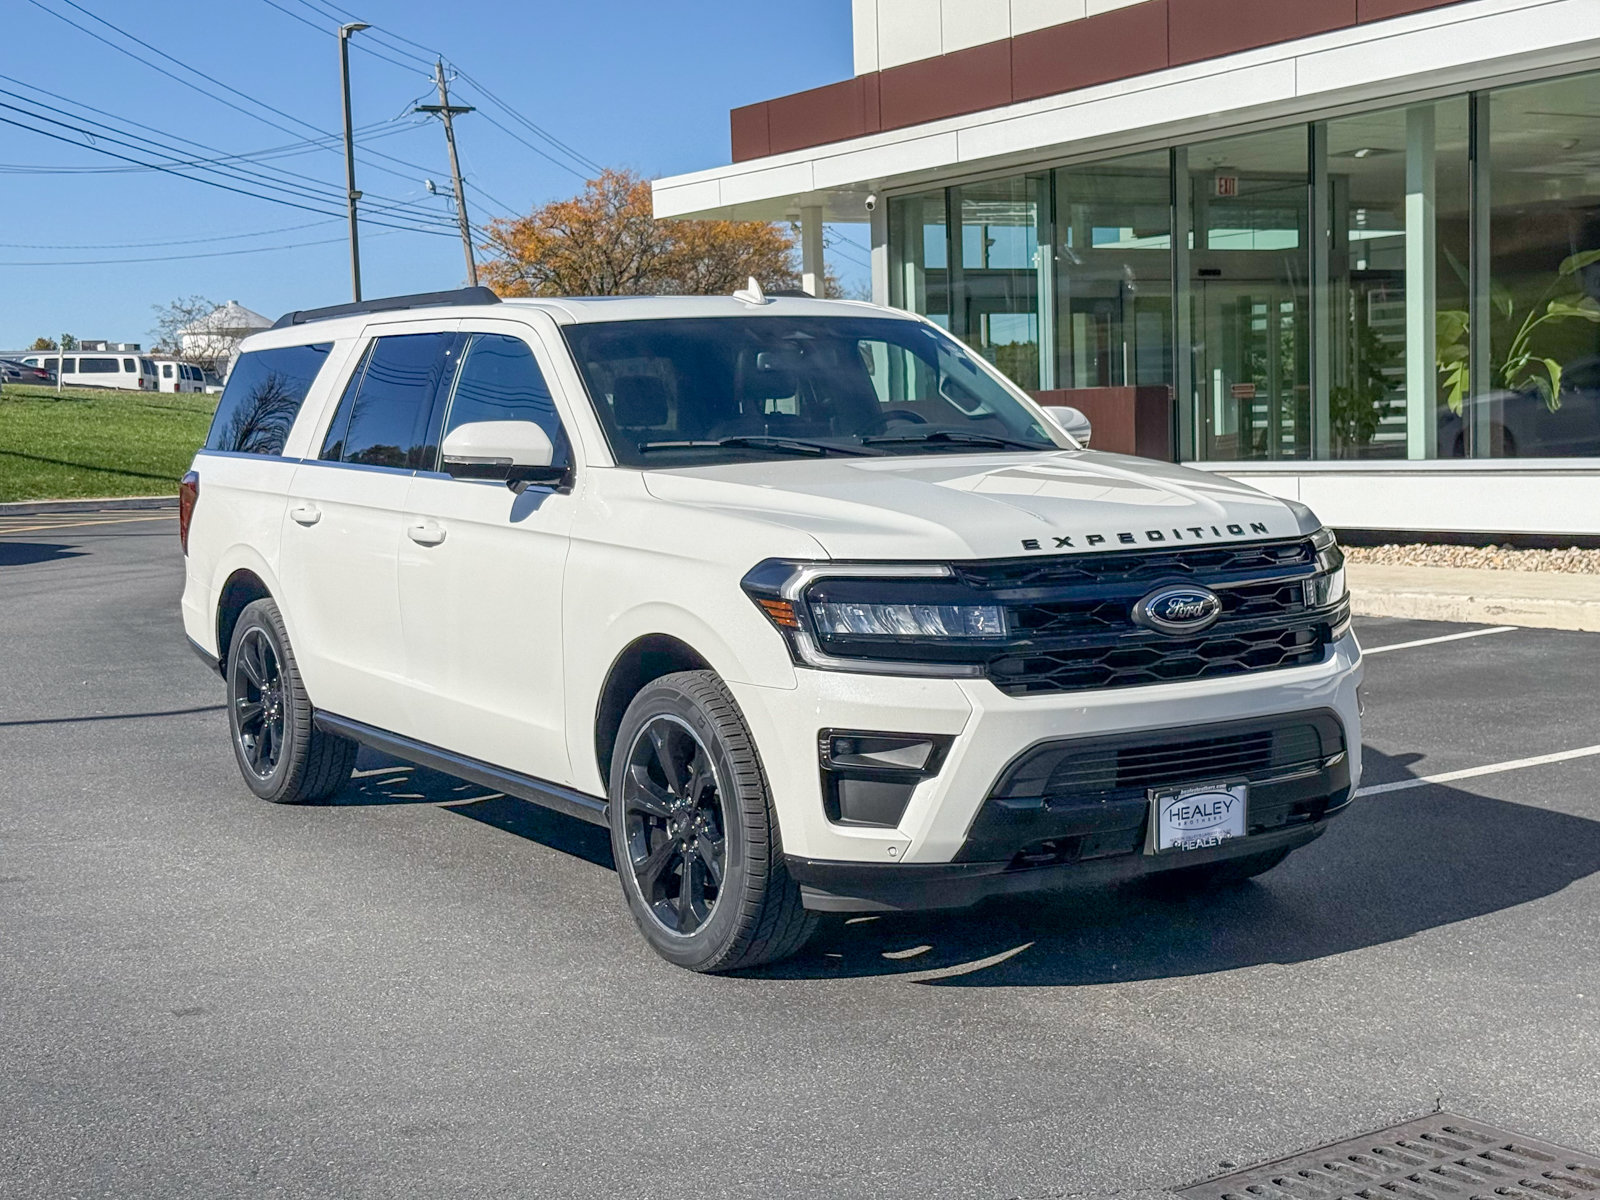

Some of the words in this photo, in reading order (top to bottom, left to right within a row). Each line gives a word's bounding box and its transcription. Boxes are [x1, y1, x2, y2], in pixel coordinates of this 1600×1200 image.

[1218, 177, 1236, 195] EXIT
[1021, 522, 1269, 550] EXPEDITION
[1166, 597, 1204, 619] Ford
[1169, 799, 1234, 822] HEALEY
[1181, 837, 1224, 851] HEALEY
